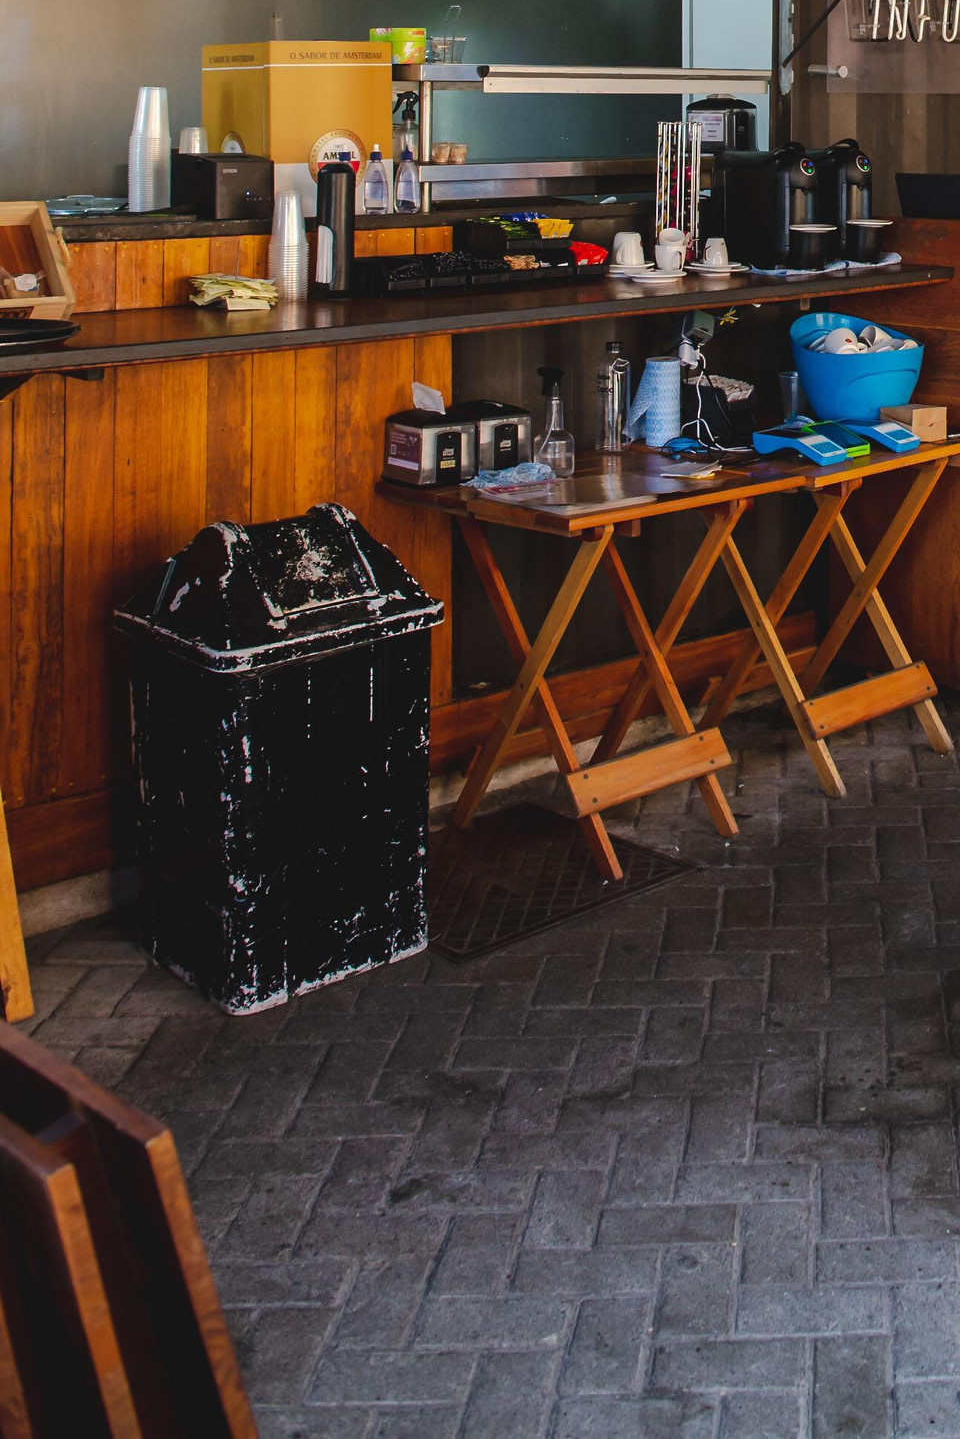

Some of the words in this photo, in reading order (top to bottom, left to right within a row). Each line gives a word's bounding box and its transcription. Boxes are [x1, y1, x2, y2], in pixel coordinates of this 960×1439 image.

[289, 52, 296, 60] O
[299, 52, 327, 60] SABOR
[342, 52, 383, 60] AMSTERDAM
[323, 151, 356, 161] AML
